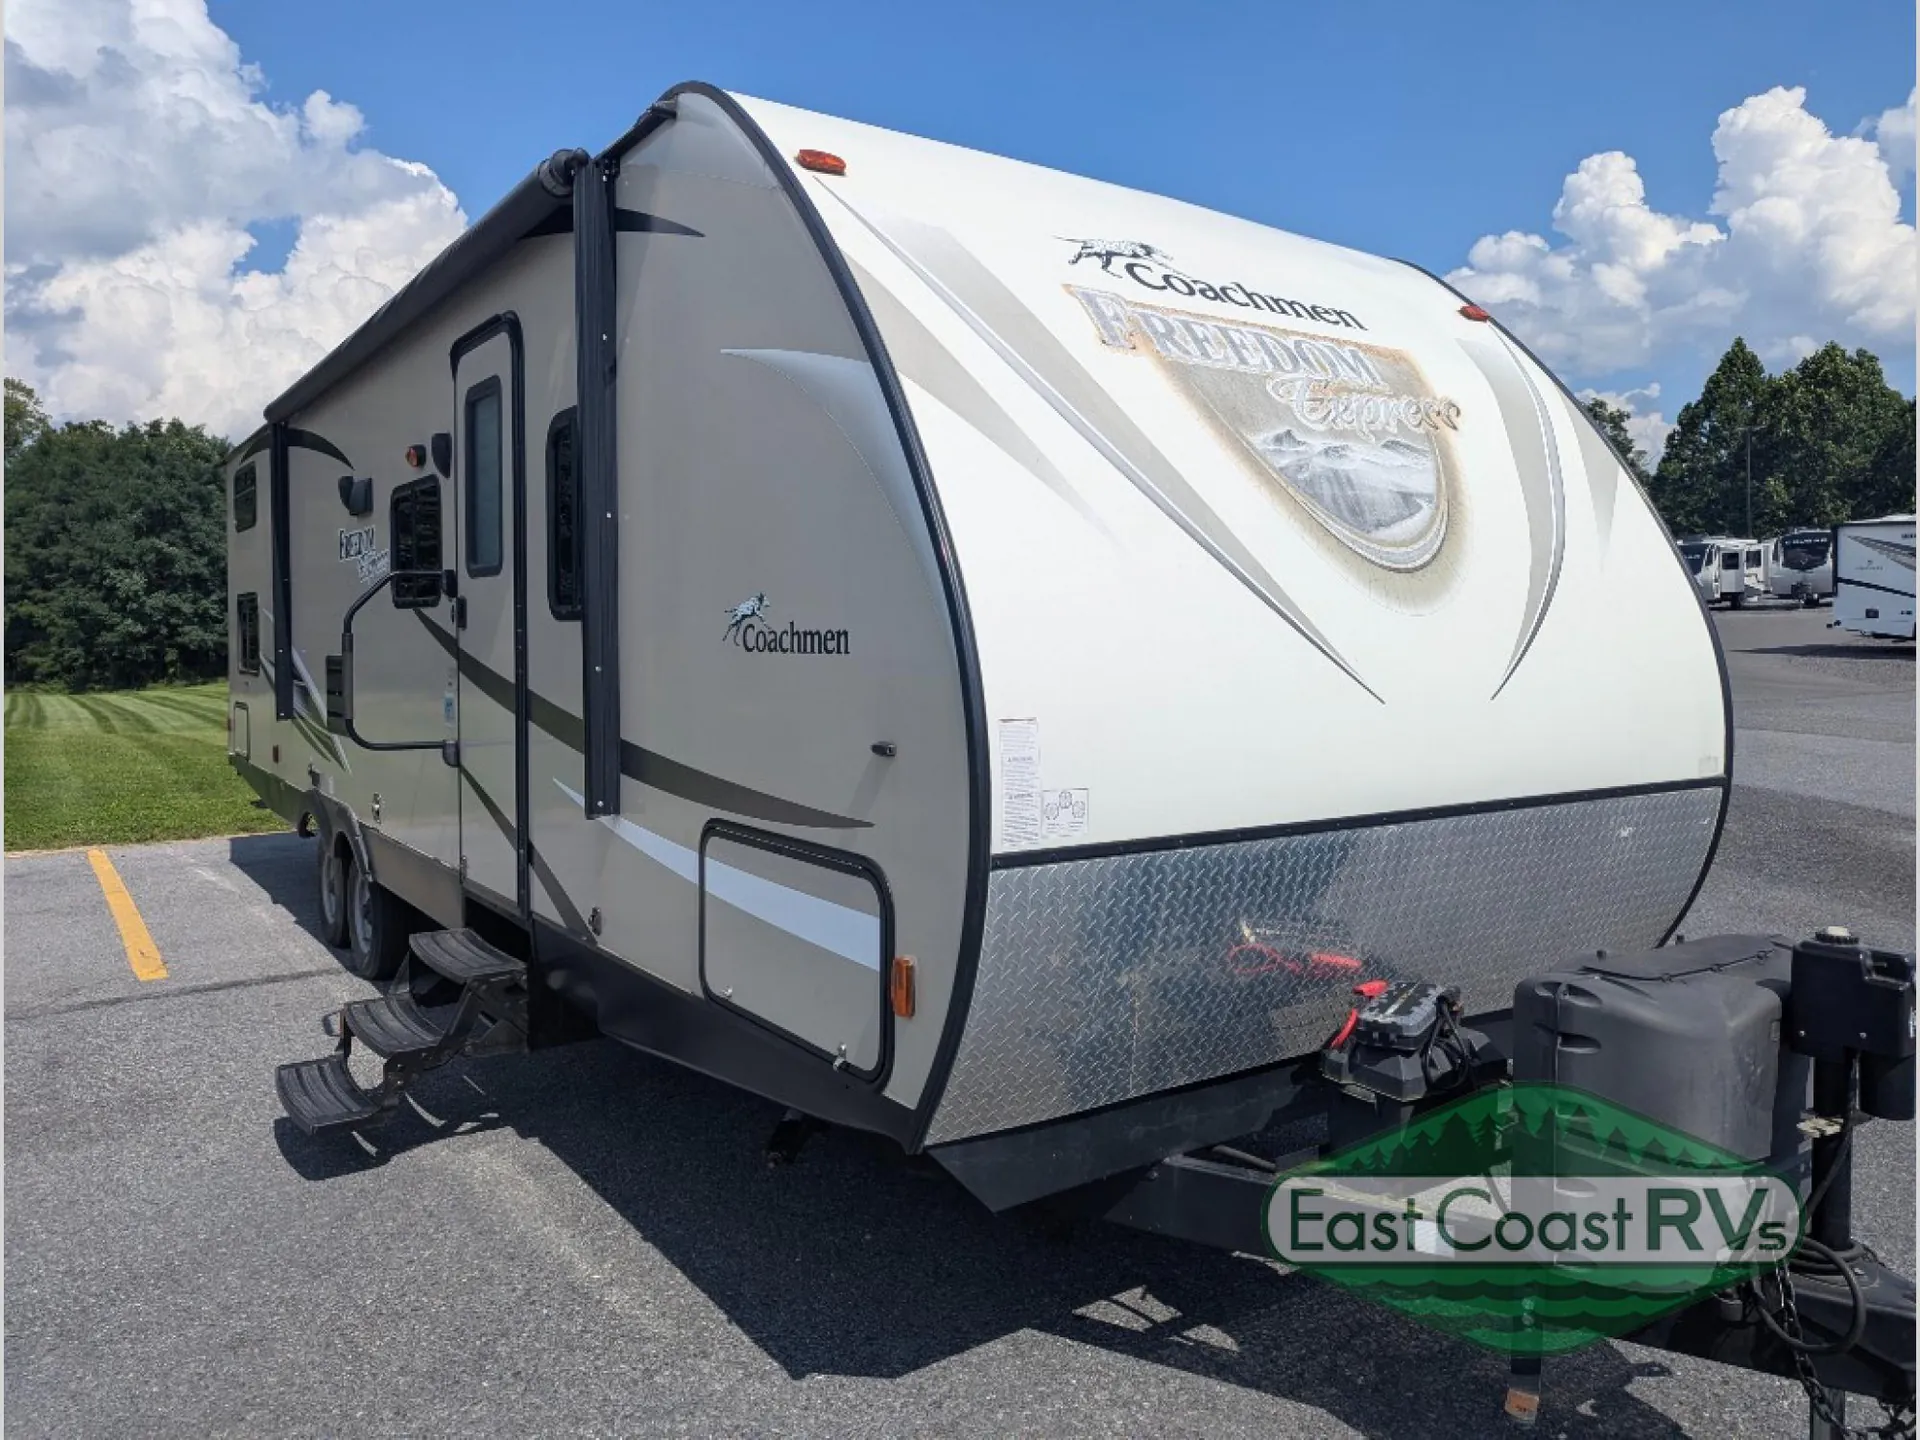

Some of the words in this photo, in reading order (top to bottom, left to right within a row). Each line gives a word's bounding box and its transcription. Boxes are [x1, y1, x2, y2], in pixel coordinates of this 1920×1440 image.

[1123, 260, 1368, 332] Coachmen
[1072, 284, 1393, 395] FREEDOM
[1266, 374, 1463, 440] Express
[742, 619, 850, 655] Coachmen
